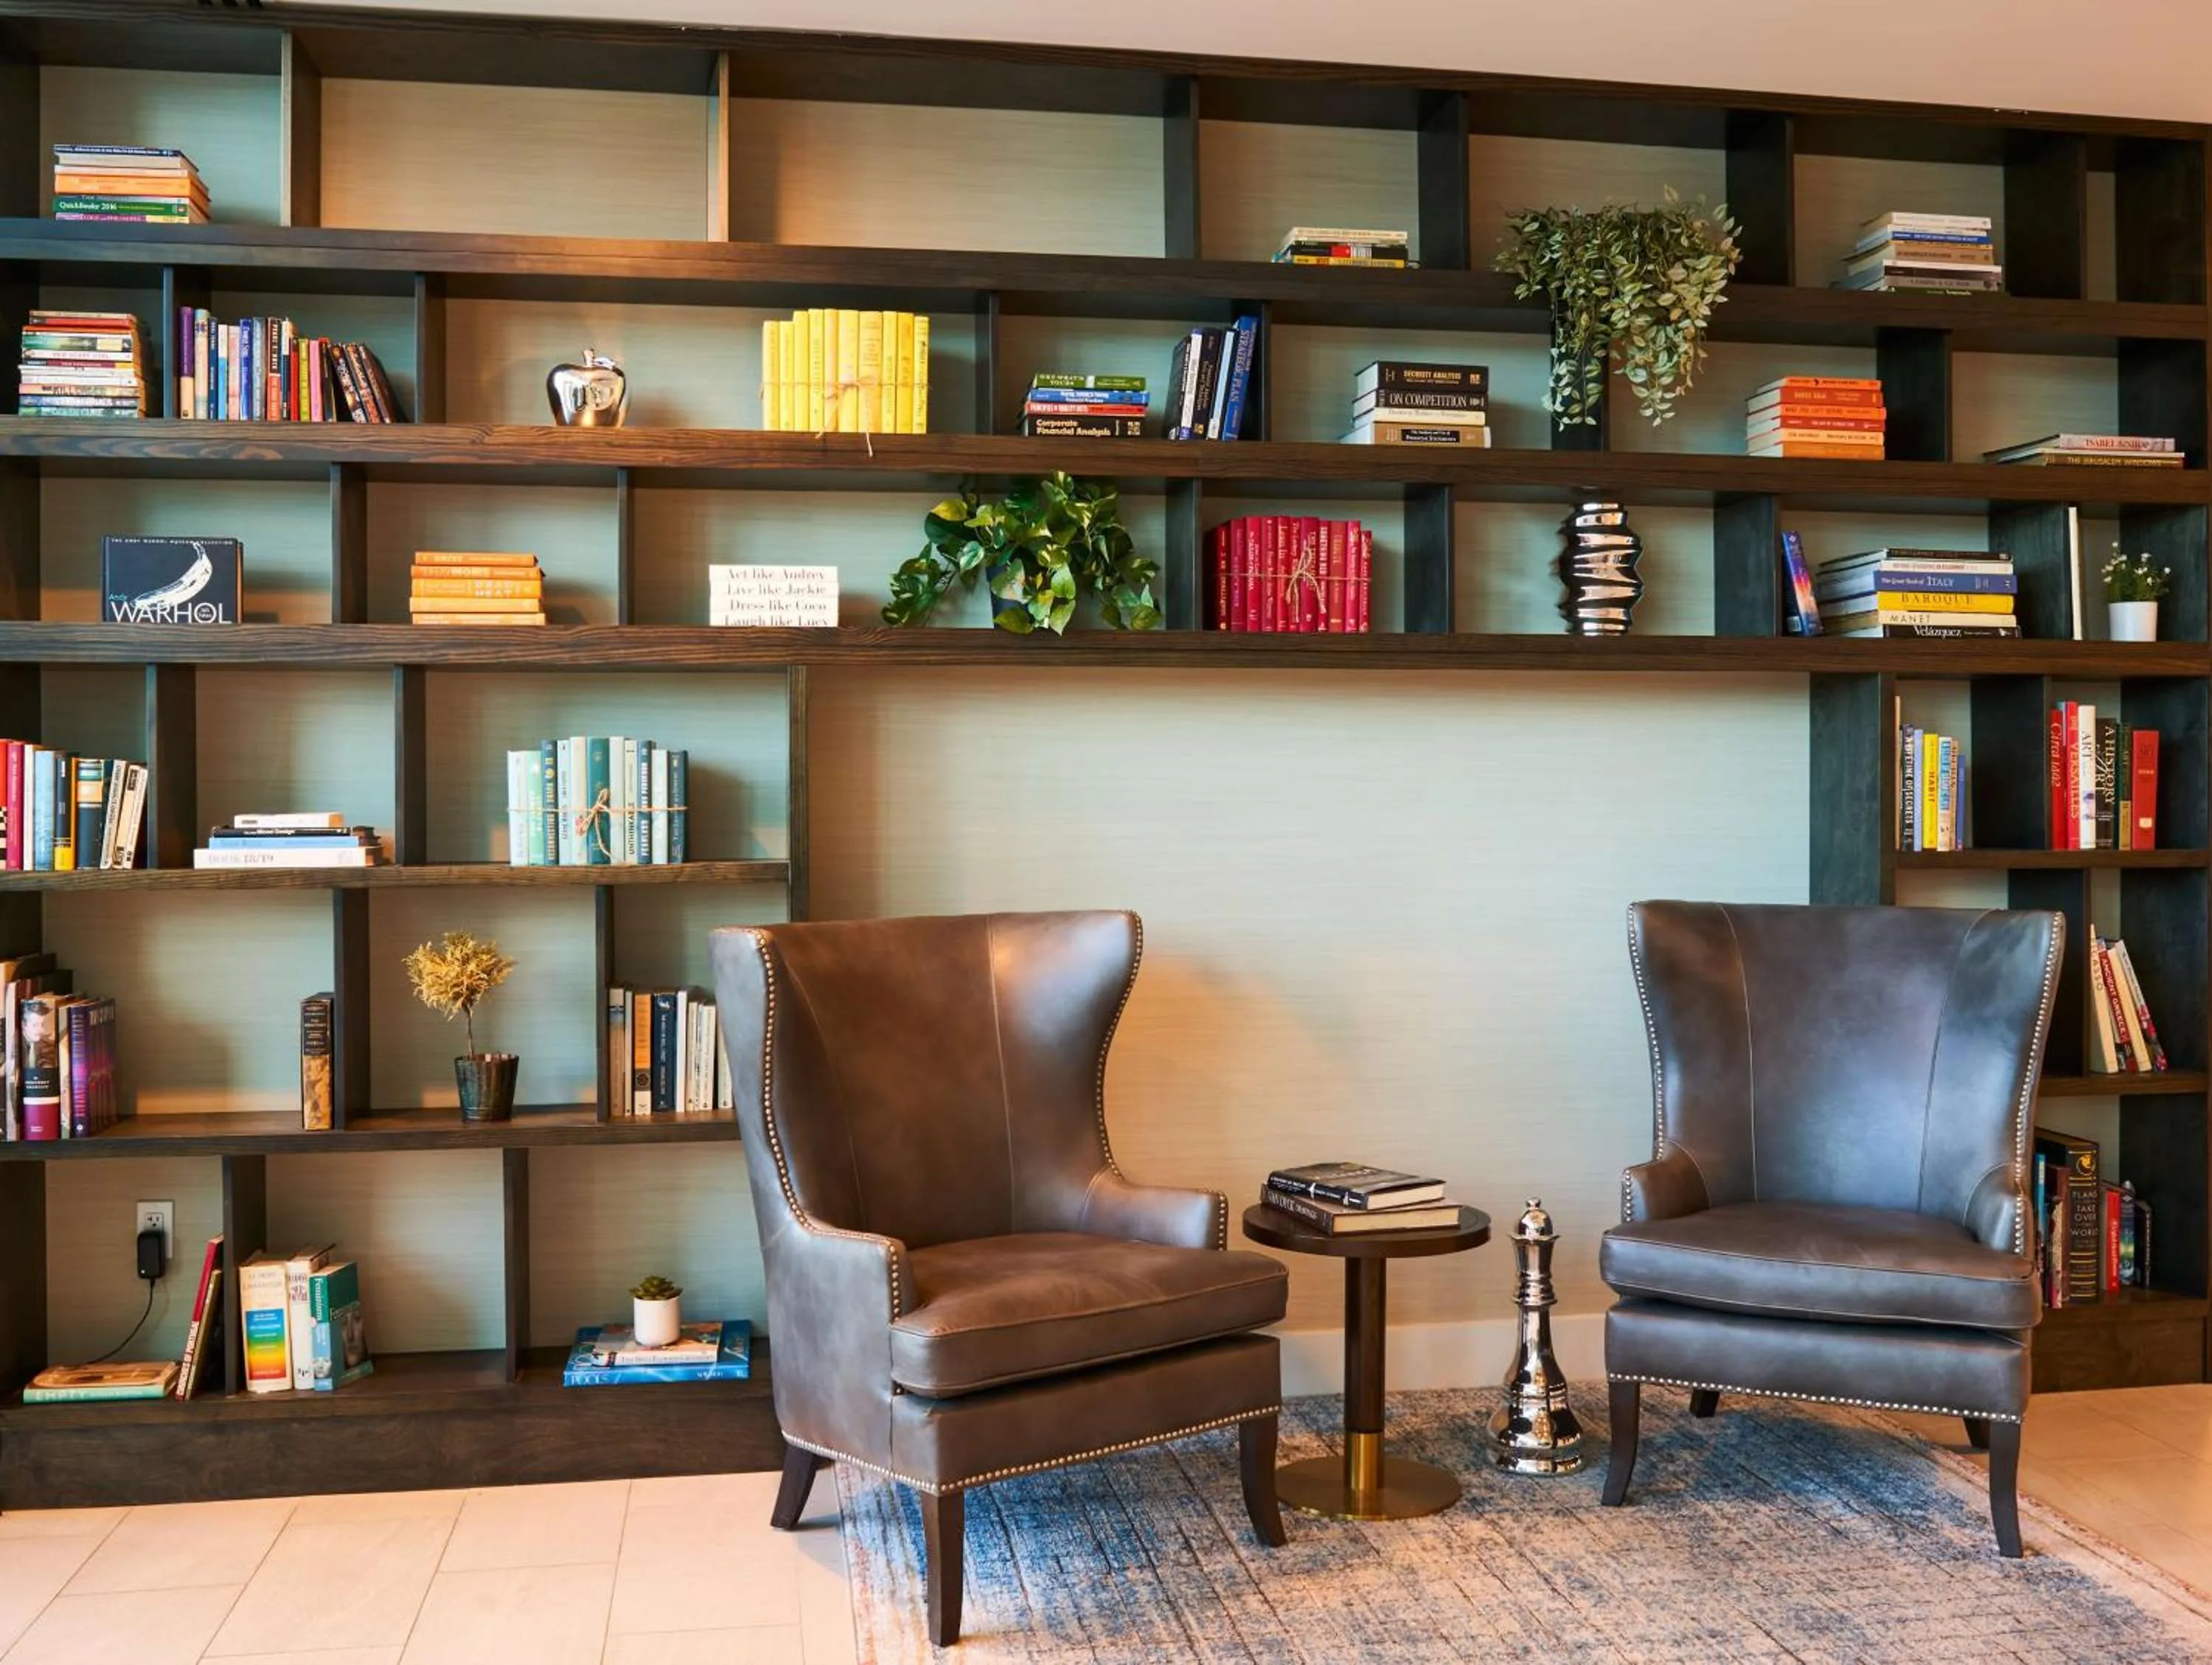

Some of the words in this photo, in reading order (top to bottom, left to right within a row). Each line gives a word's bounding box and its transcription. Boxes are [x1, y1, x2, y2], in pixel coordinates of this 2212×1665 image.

[1234, 330, 1251, 378] STRATEGIC
[1403, 370, 1432, 379] SECURITY
[1433, 371, 1462, 380] ANALYSIS
[1229, 378, 1243, 403] PLAN
[1390, 393, 1402, 405] ON
[1404, 393, 1467, 407] COMPETITION
[1036, 419, 1078, 428] Corporate
[1036, 427, 1075, 436] Financial
[1076, 428, 1111, 437] Analysis
[2085, 439, 2114, 447] ISABEL
[2067, 456, 2081, 465] THE
[2082, 457, 2122, 466] JERUSALEM
[729, 568, 747, 579] Act
[753, 568, 774, 579] like
[1927, 576, 1954, 586] ITALY
[727, 583, 754, 595] Live
[758, 583, 780, 595] like
[785, 583, 827, 596] Jackie
[1902, 592, 1972, 605] BAROQUE
[731, 599, 765, 611] Dress
[768, 599, 792, 611] like
[796, 599, 827, 611] Coco
[111, 601, 232, 624] WARHOL
[1889, 614, 1931, 623] MANET
[724, 615, 766, 626] Laugh
[771, 615, 793, 626] like
[2051, 723, 2062, 758] Circa
[2081, 731, 2093, 761] ART
[1905, 744, 1913, 778] LIFETIME
[2105, 734, 2115, 805] HISTORY
[2070, 743, 2079, 818] VERSAILLES
[1905, 791, 1913, 824] SECRETS
[2101, 958, 2115, 996] ANCIENT
[2112, 998, 2126, 1035] GREECE
[2076, 1204, 2096, 1212] TAKE
[2074, 1214, 2097, 1222] OVER
[35, 1391, 85, 1400] EMPTY
